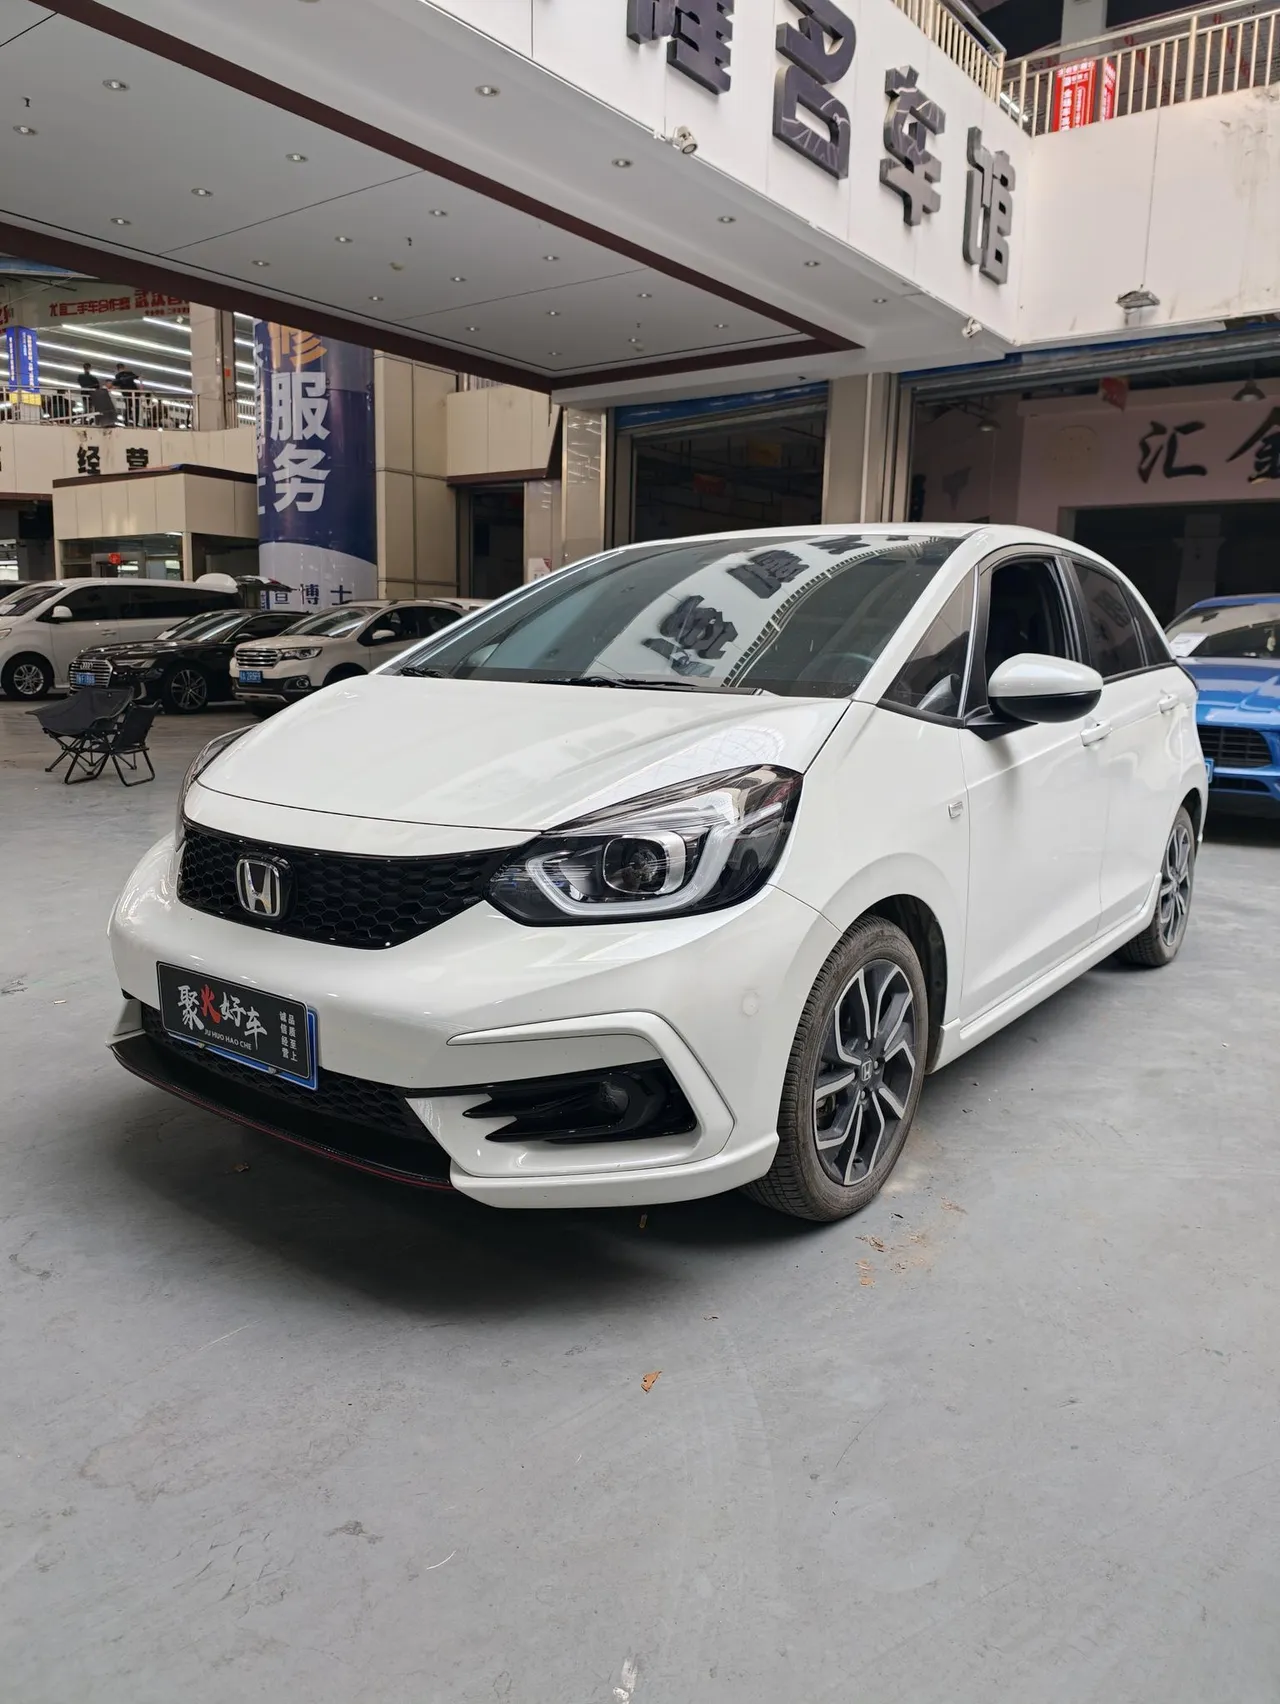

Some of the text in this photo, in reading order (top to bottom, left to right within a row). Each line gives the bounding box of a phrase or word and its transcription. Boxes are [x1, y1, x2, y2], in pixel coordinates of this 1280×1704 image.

[77, 444, 149, 474] 经营
[177, 984, 268, 1050] 聚火好车
[225, 1035, 239, 1046] HAO
[240, 1040, 252, 1051] CHE
[288, 1013, 298, 1062] 品质至上
